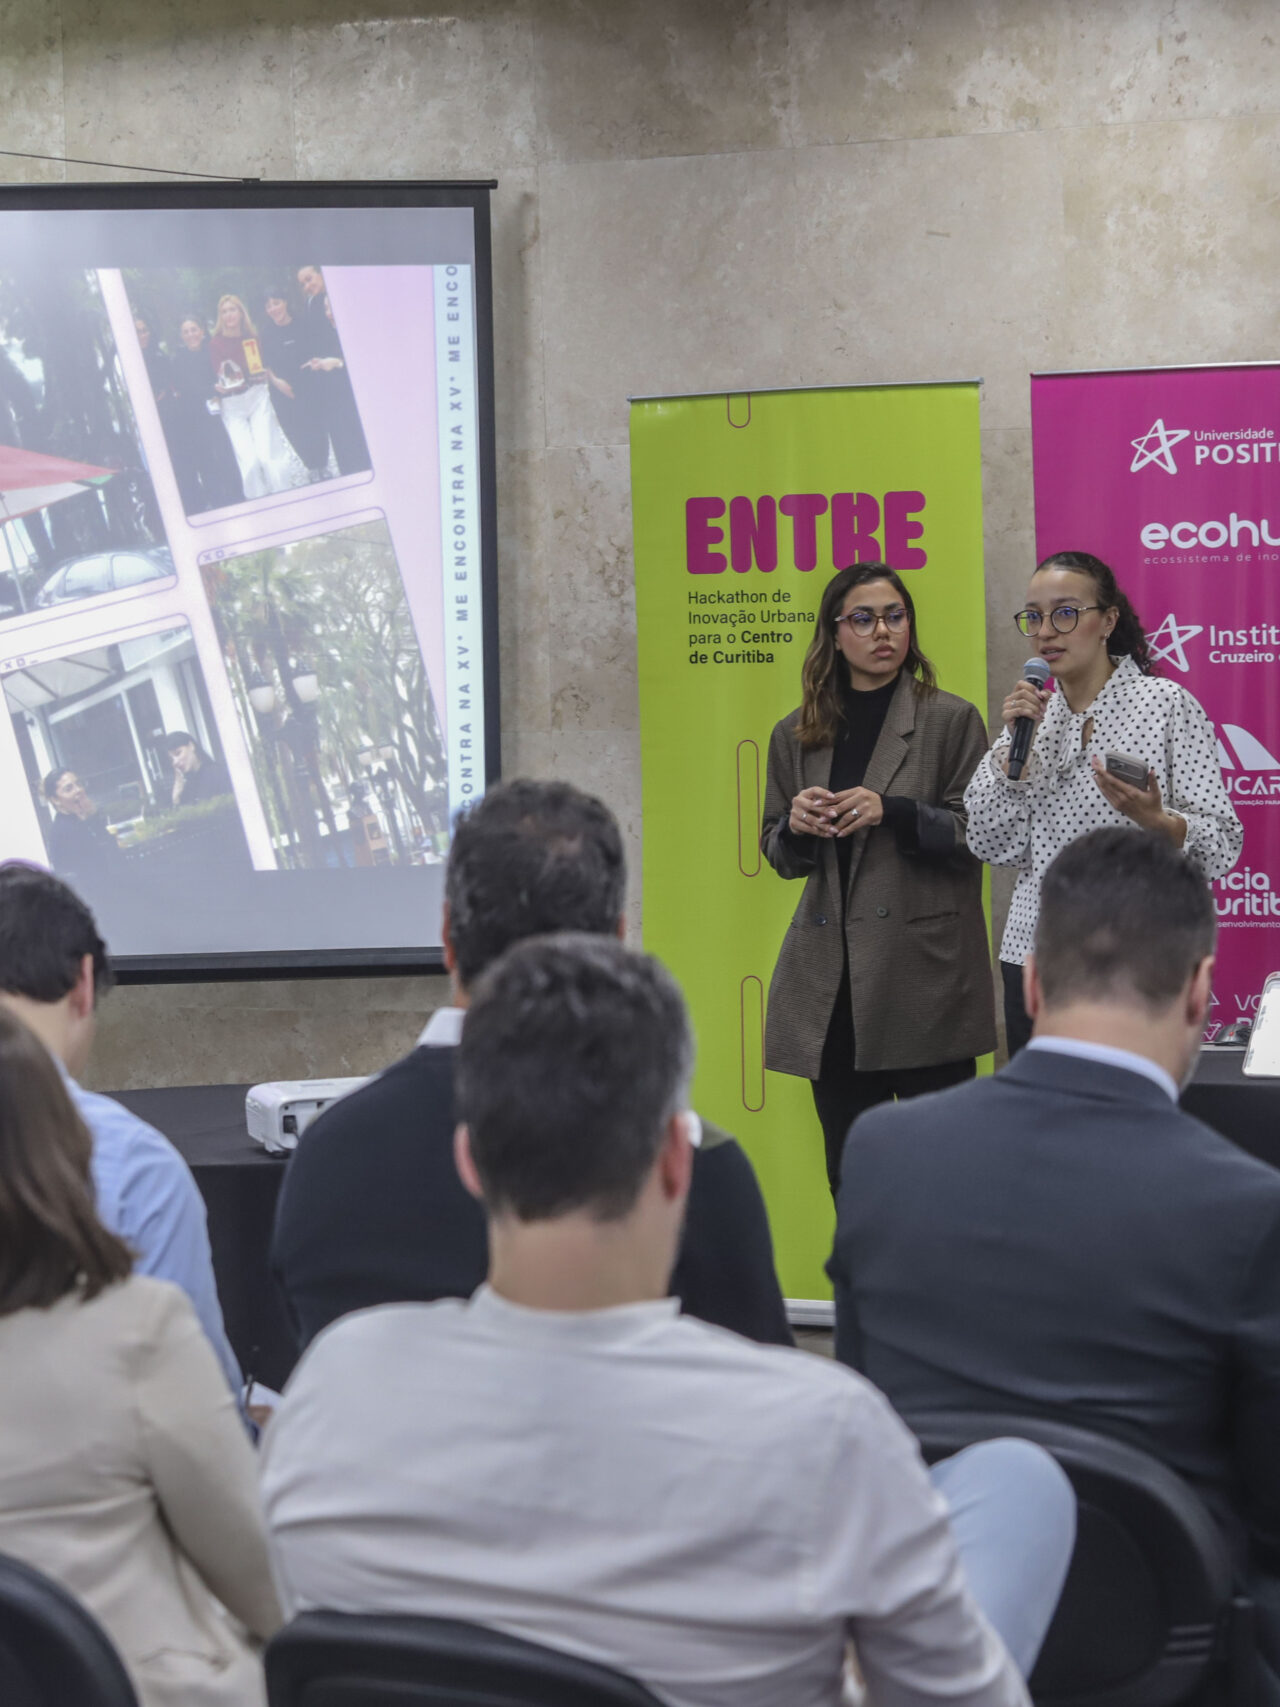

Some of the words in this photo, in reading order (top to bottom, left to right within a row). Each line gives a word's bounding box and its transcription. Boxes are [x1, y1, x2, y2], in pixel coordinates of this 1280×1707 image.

[445, 265, 460, 322] ENCO
[448, 336, 461, 362] ME
[450, 424, 464, 450] NA
[1194, 428, 1274, 441] Universidade
[451, 463, 468, 581] ENCONTRA
[686, 490, 927, 574] ENTRE
[1144, 555, 1229, 564] ecossistema
[1236, 553, 1252, 562] de
[688, 589, 768, 604] Hackathon
[771, 589, 791, 603] de
[455, 594, 469, 621] ME
[688, 611, 756, 627] Inovação
[760, 610, 815, 623] Urbana
[689, 633, 721, 647] para
[726, 633, 736, 644] o
[740, 630, 793, 643] Centro
[689, 651, 708, 664] de
[713, 651, 775, 664] Curitiba
[1209, 650, 1275, 663] Cruzeiro
[458, 683, 471, 709] NA
